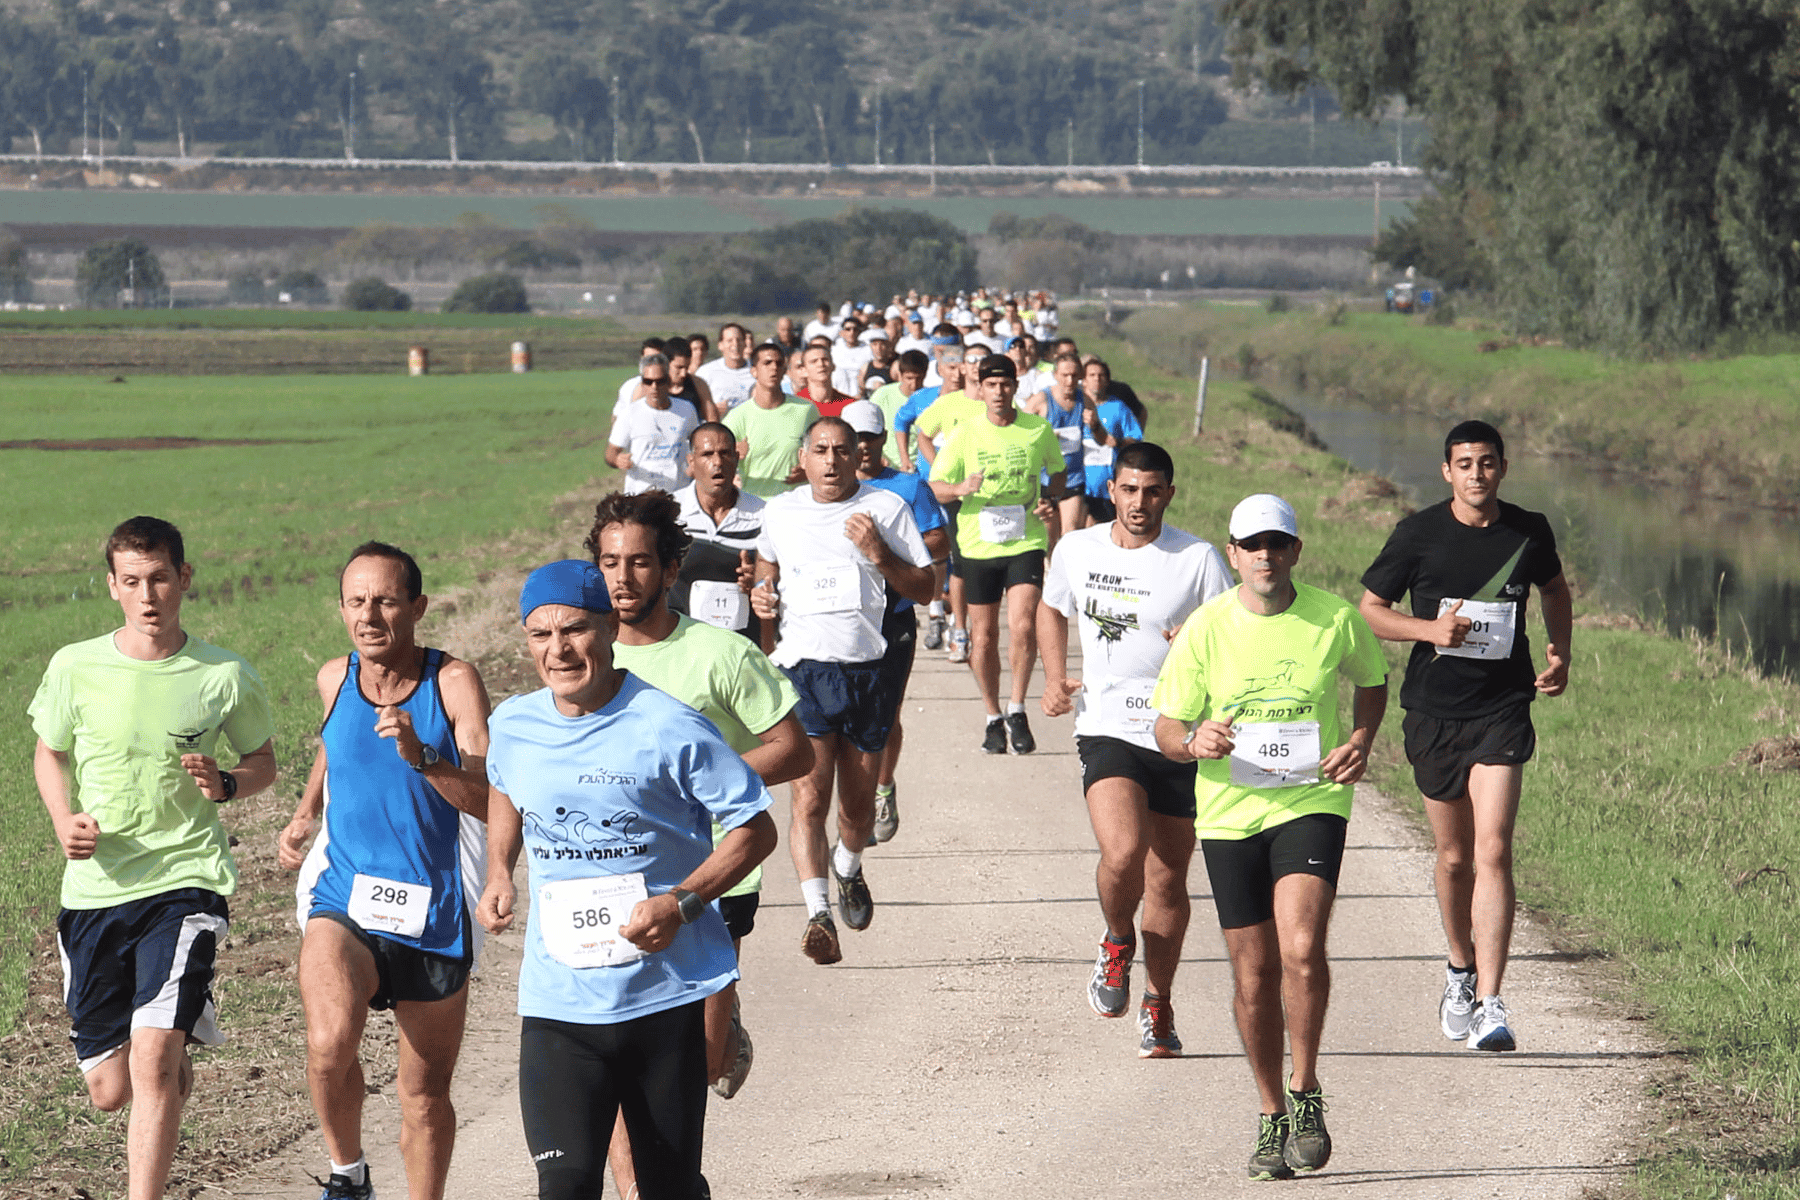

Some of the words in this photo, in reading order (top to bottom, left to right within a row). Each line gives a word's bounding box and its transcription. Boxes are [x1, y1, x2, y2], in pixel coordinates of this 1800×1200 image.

[992, 516, 1010, 526] 560
[813, 577, 837, 590] 328
[1088, 571, 1101, 583] WE
[1102, 574, 1122, 585] RUN
[715, 598, 727, 608] 11
[1472, 620, 1490, 633] 01
[1265, 708, 1293, 718] רמת
[1258, 743, 1290, 758] 485
[554, 846, 583, 860] גליל
[371, 885, 409, 906] 298
[572, 907, 611, 929] 586
